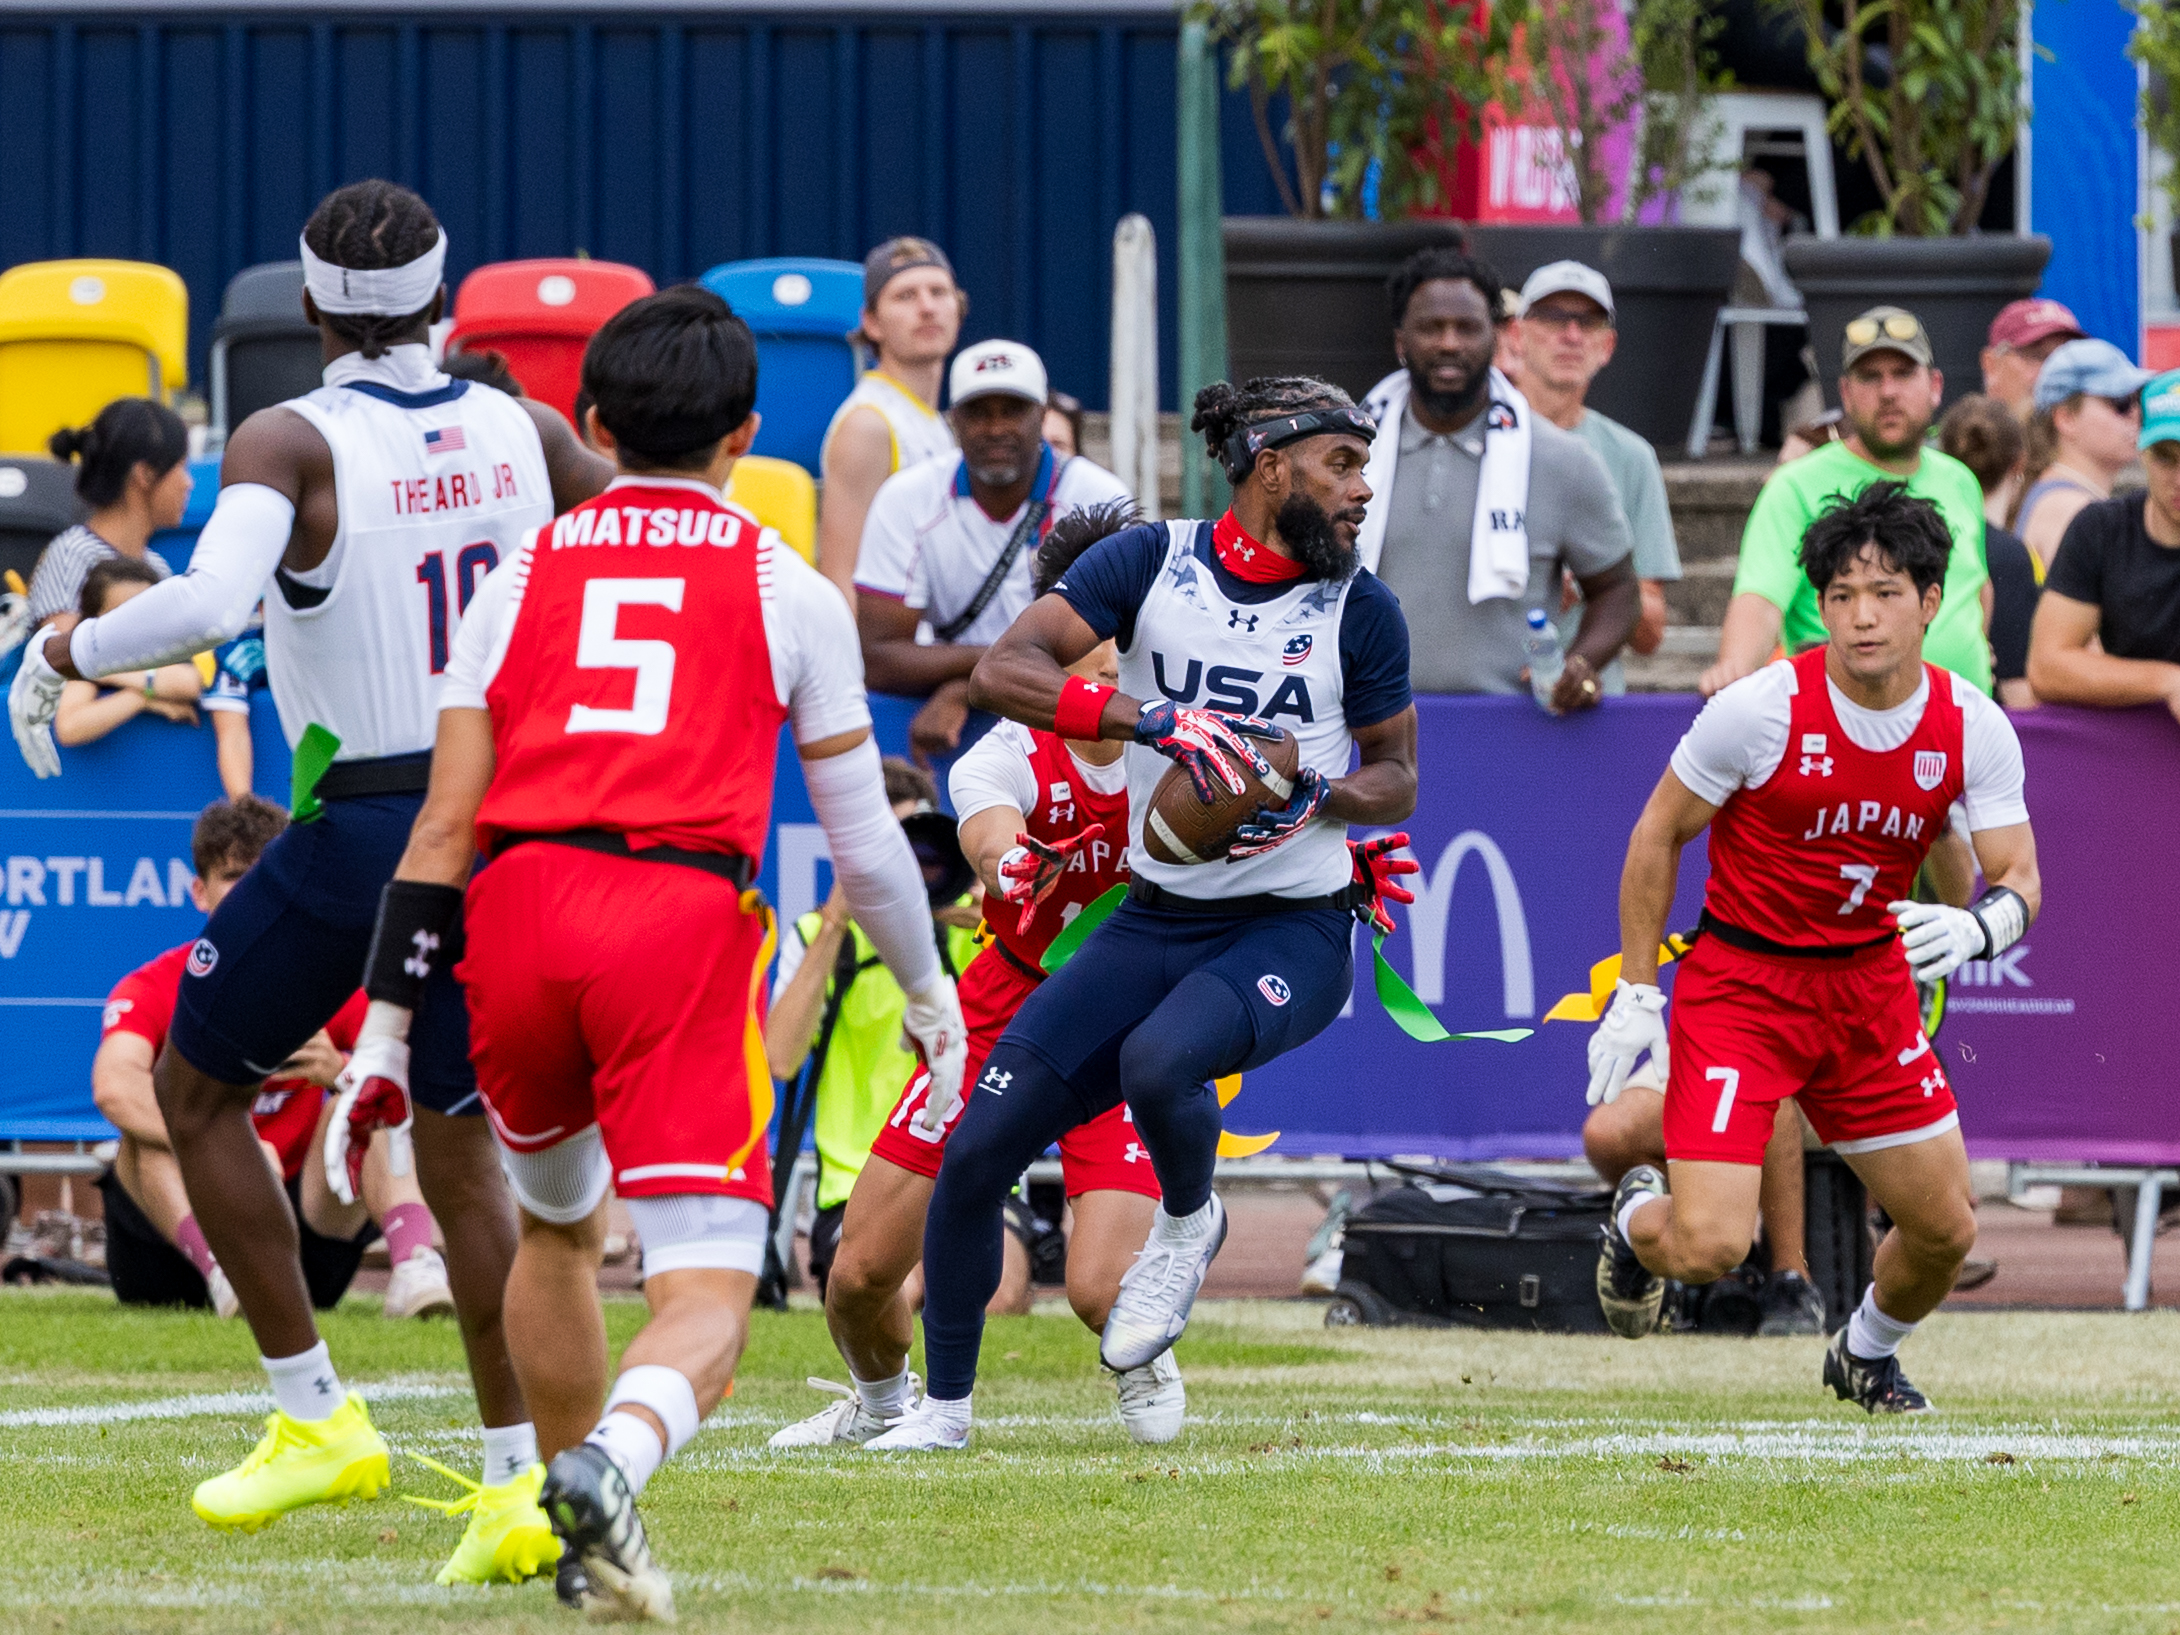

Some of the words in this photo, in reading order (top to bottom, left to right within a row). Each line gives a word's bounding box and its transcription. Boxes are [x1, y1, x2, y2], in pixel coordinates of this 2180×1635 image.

[1288, 418, 1298, 431] 1
[493, 463, 518, 499] JR
[552, 507, 742, 550] MATSUO
[564, 577, 686, 735] 5
[1151, 651, 1314, 723] USA
[1804, 801, 1925, 841] JAPAN
[1067, 838, 1130, 873] APA
[0, 856, 195, 907] RTLAN
[1837, 864, 1880, 915] 7
[1705, 1066, 1740, 1133] 7
